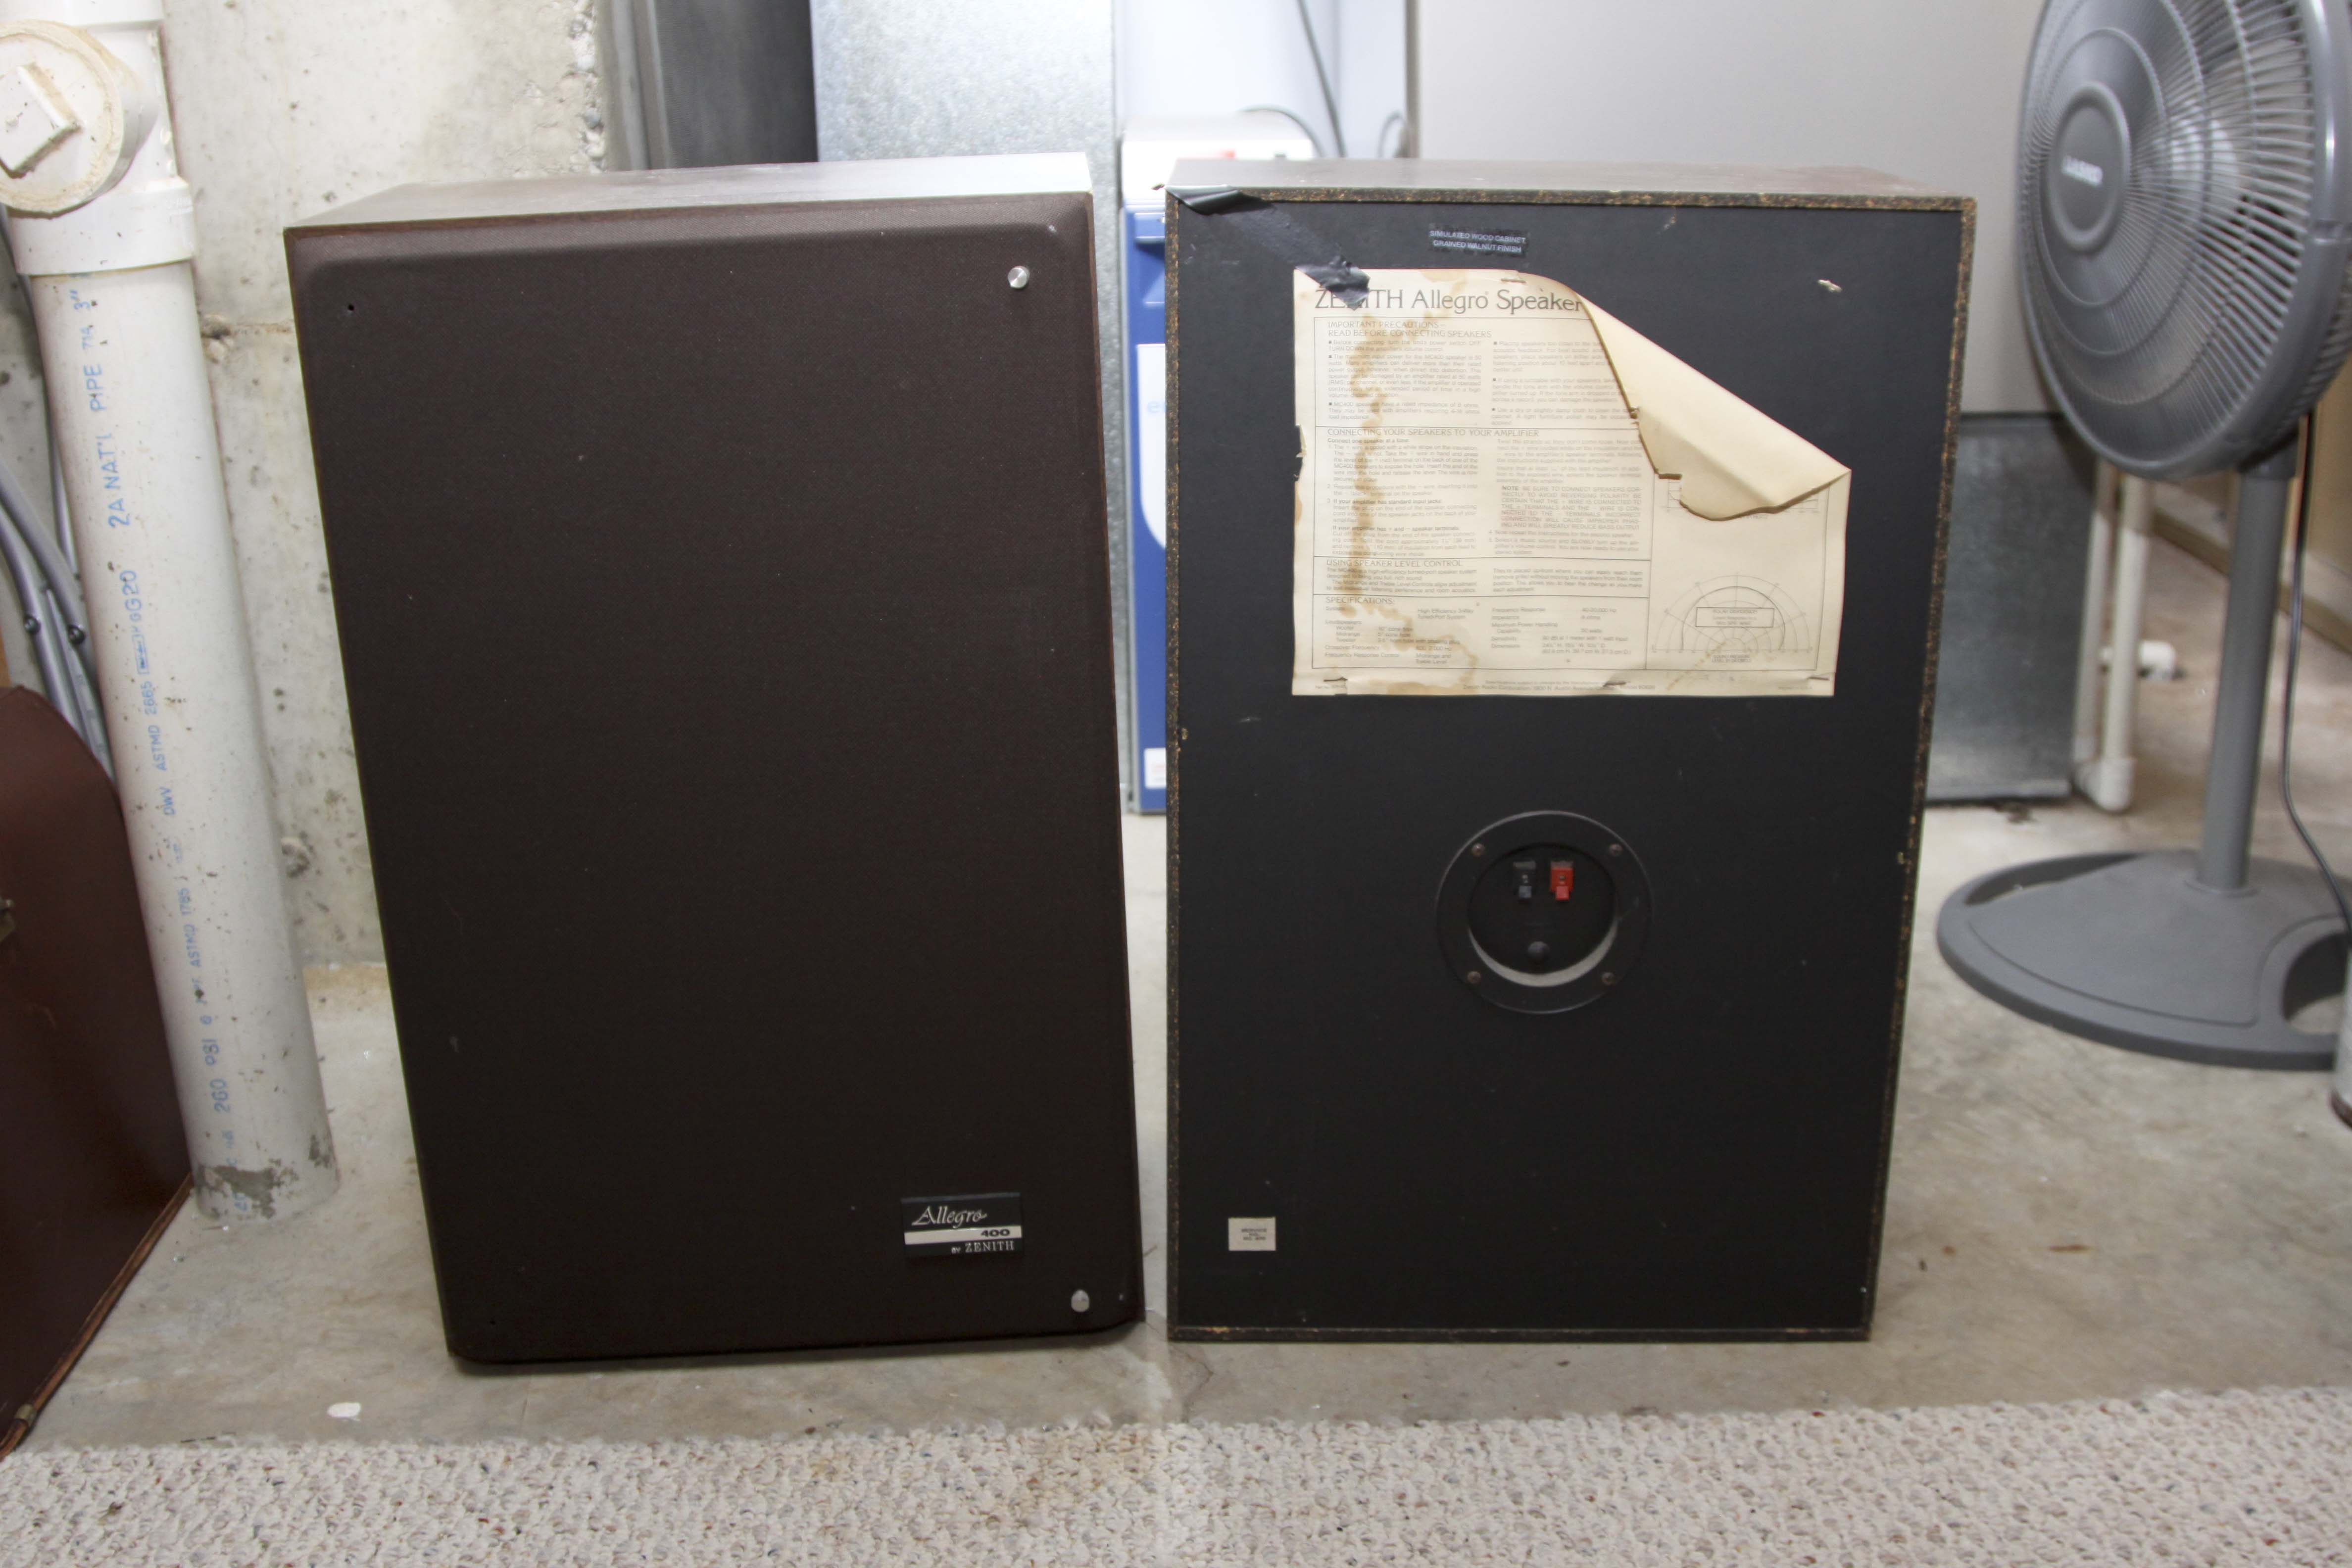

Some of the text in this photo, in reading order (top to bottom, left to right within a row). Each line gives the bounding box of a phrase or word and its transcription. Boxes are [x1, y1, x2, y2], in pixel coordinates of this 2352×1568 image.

[1429, 230, 1470, 239] SIMULATED
[1495, 235, 1525, 244] CABINET
[1433, 240, 1521, 253] GRAINED WALNUT FINISH
[1315, 289, 1403, 308] ZEITH
[1497, 290, 1582, 314] Speaker
[83, 364, 107, 411] PIPE
[140, 681, 157, 716] 2665
[147, 725, 167, 771] ASTMD
[159, 787, 176, 817] DWV
[911, 1205, 987, 1228] Allegro
[980, 1228, 1010, 1237] 400
[965, 1240, 1015, 1253] ZENITH
